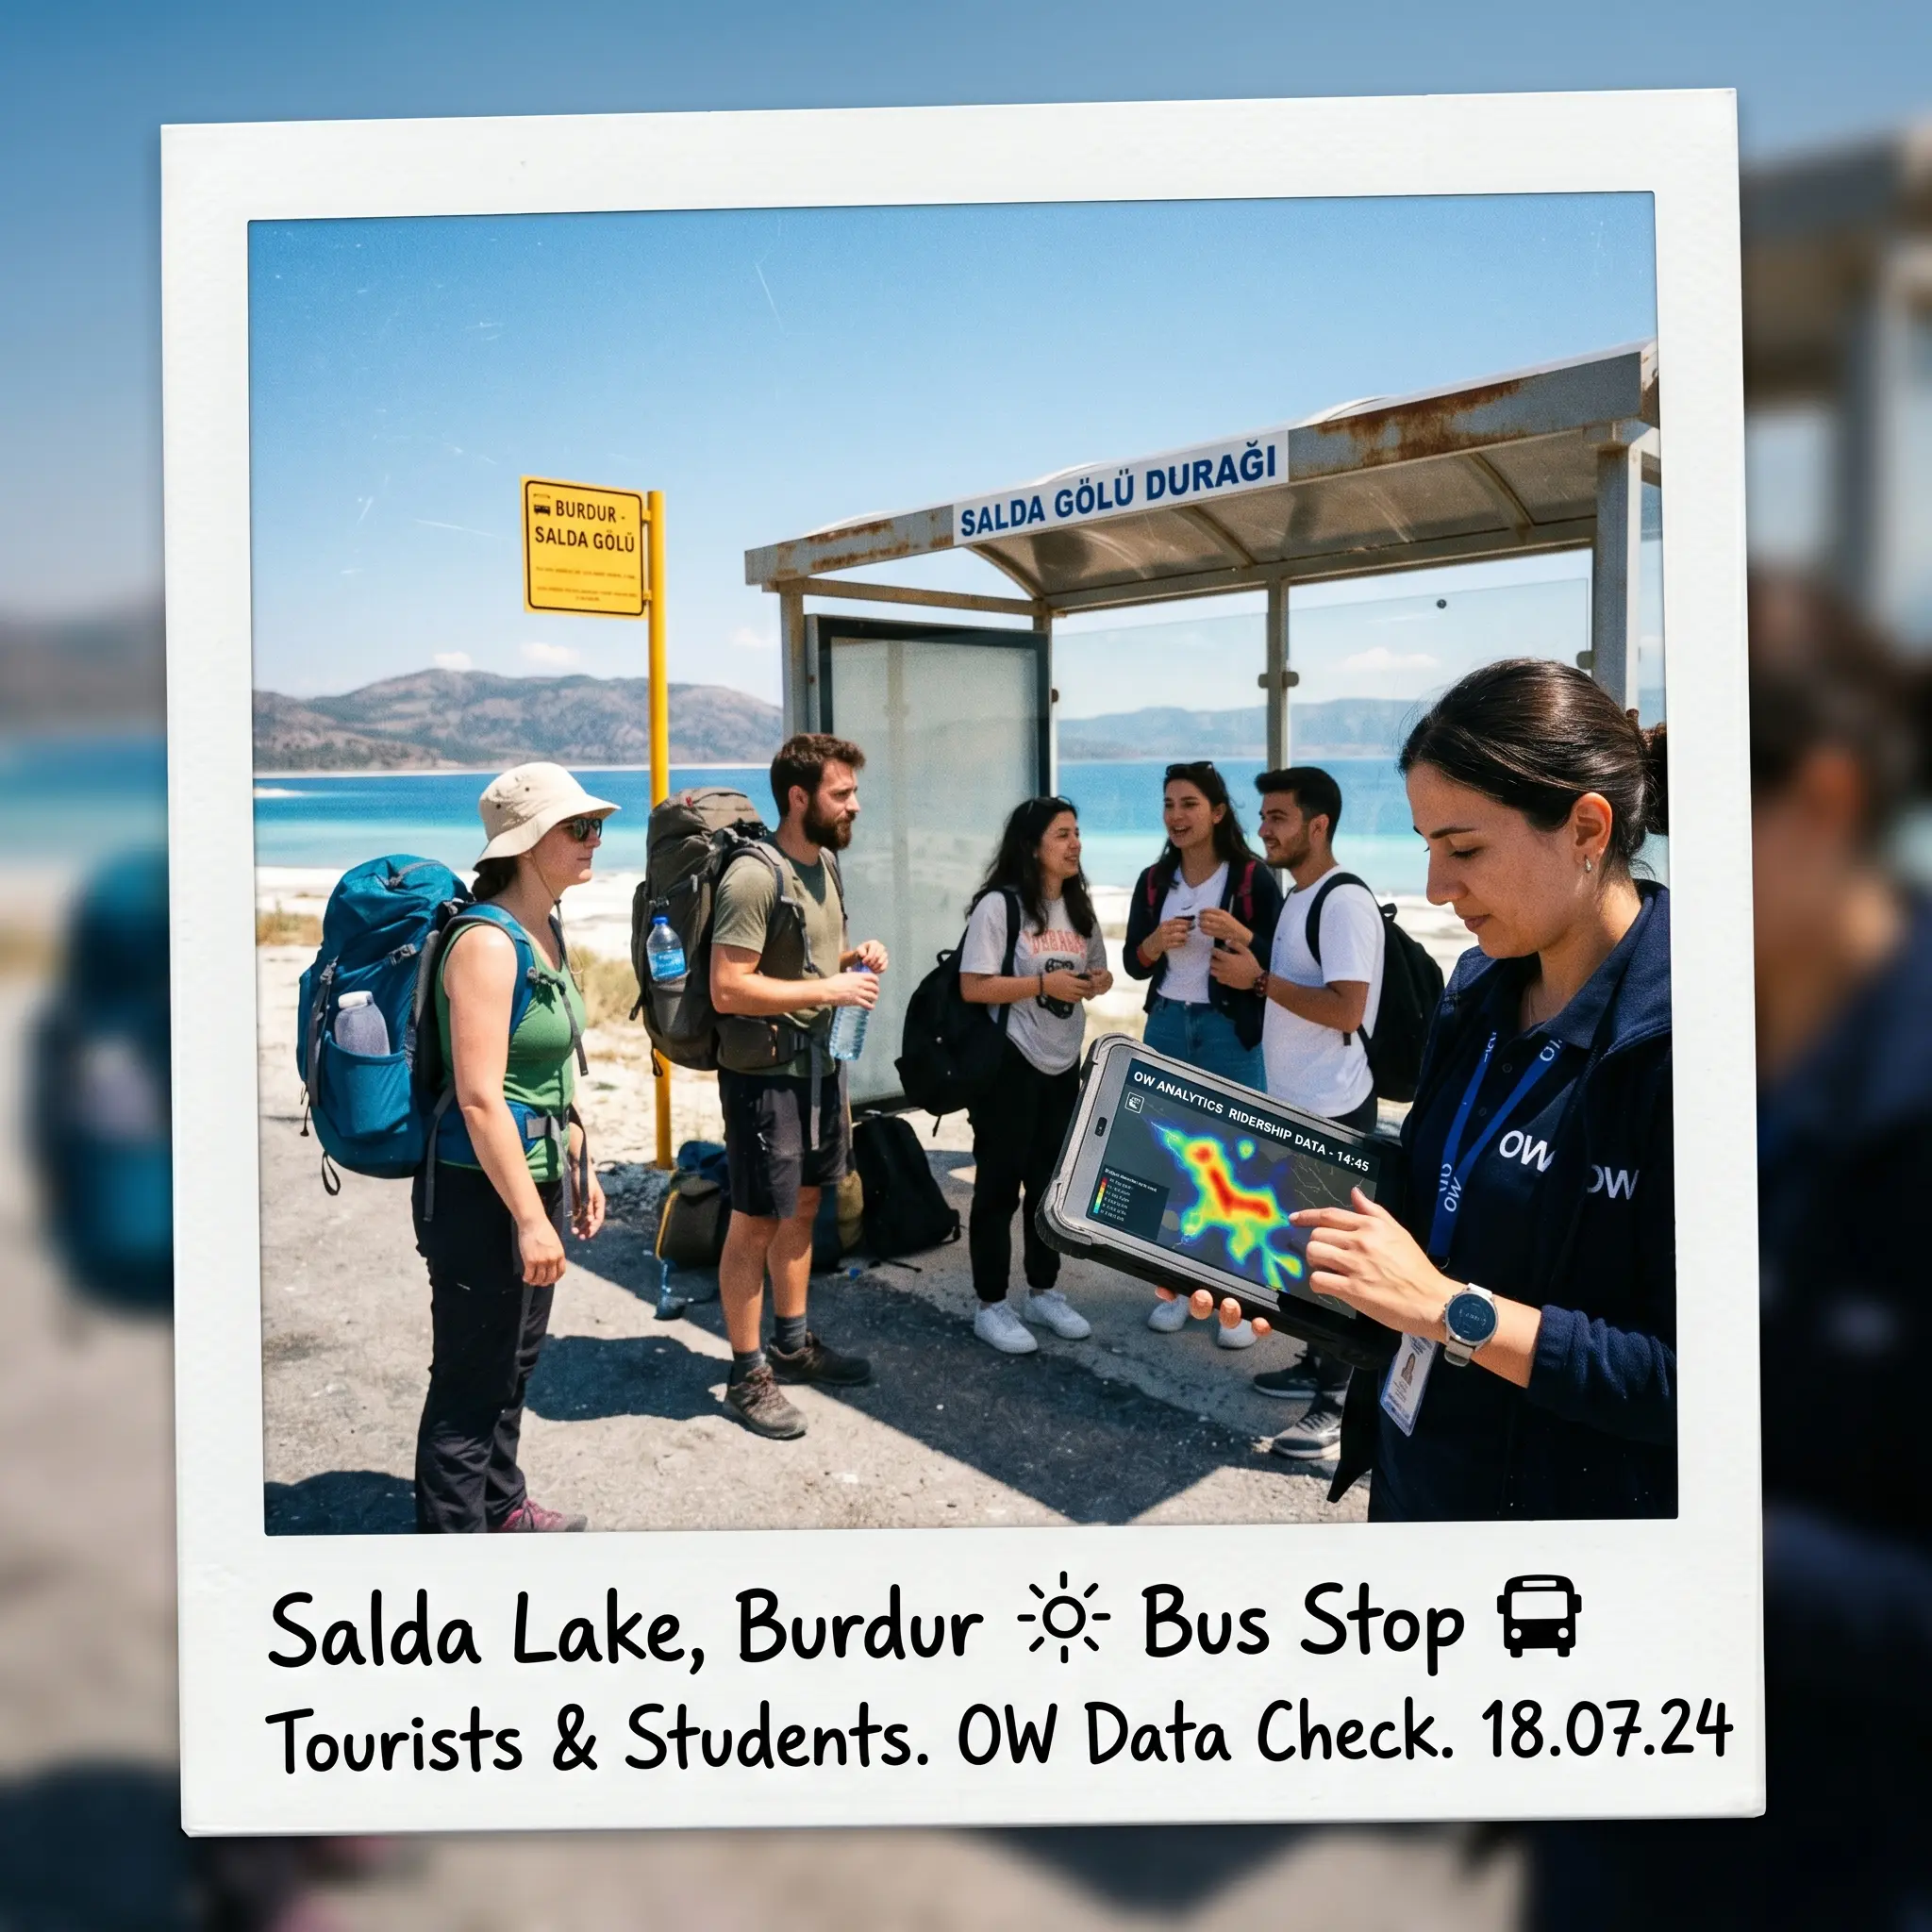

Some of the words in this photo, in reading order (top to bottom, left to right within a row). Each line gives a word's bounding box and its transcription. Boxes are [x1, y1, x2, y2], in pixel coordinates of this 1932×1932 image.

[556, 500, 616, 523] BURDUR
[960, 495, 1045, 537] SALDA
[1055, 469, 1134, 519] GÖLÜ
[1146, 440, 1276, 501] DURAĞI
[535, 526, 588, 548] SALDA
[593, 529, 635, 553] GÖLÜ
[1134, 1071, 1156, 1088] OW
[1156, 1080, 1224, 1114] ANALYTICS
[1228, 1108, 1292, 1140] RIDERSHIP
[1294, 1134, 1326, 1156] DATA
[1337, 1151, 1370, 1173] 14:45
[1499, 1130, 1556, 1173] OW
[268, 1589, 482, 1669] Salda
[513, 1588, 705, 1675] Lake,
[735, 1584, 984, 1663] Burdur
[1141, 1584, 1270, 1658] Bus
[1301, 1582, 1465, 1677] Stop
[265, 1706, 523, 1774] Tourists
[552, 1703, 598, 1772] &
[625, 1699, 929, 1771] Students.
[958, 1704, 1058, 1766] OW
[1084, 1700, 1232, 1765] Data
[1257, 1696, 1454, 1762] Check.
[1482, 1697, 1734, 1758] 18.07.24
